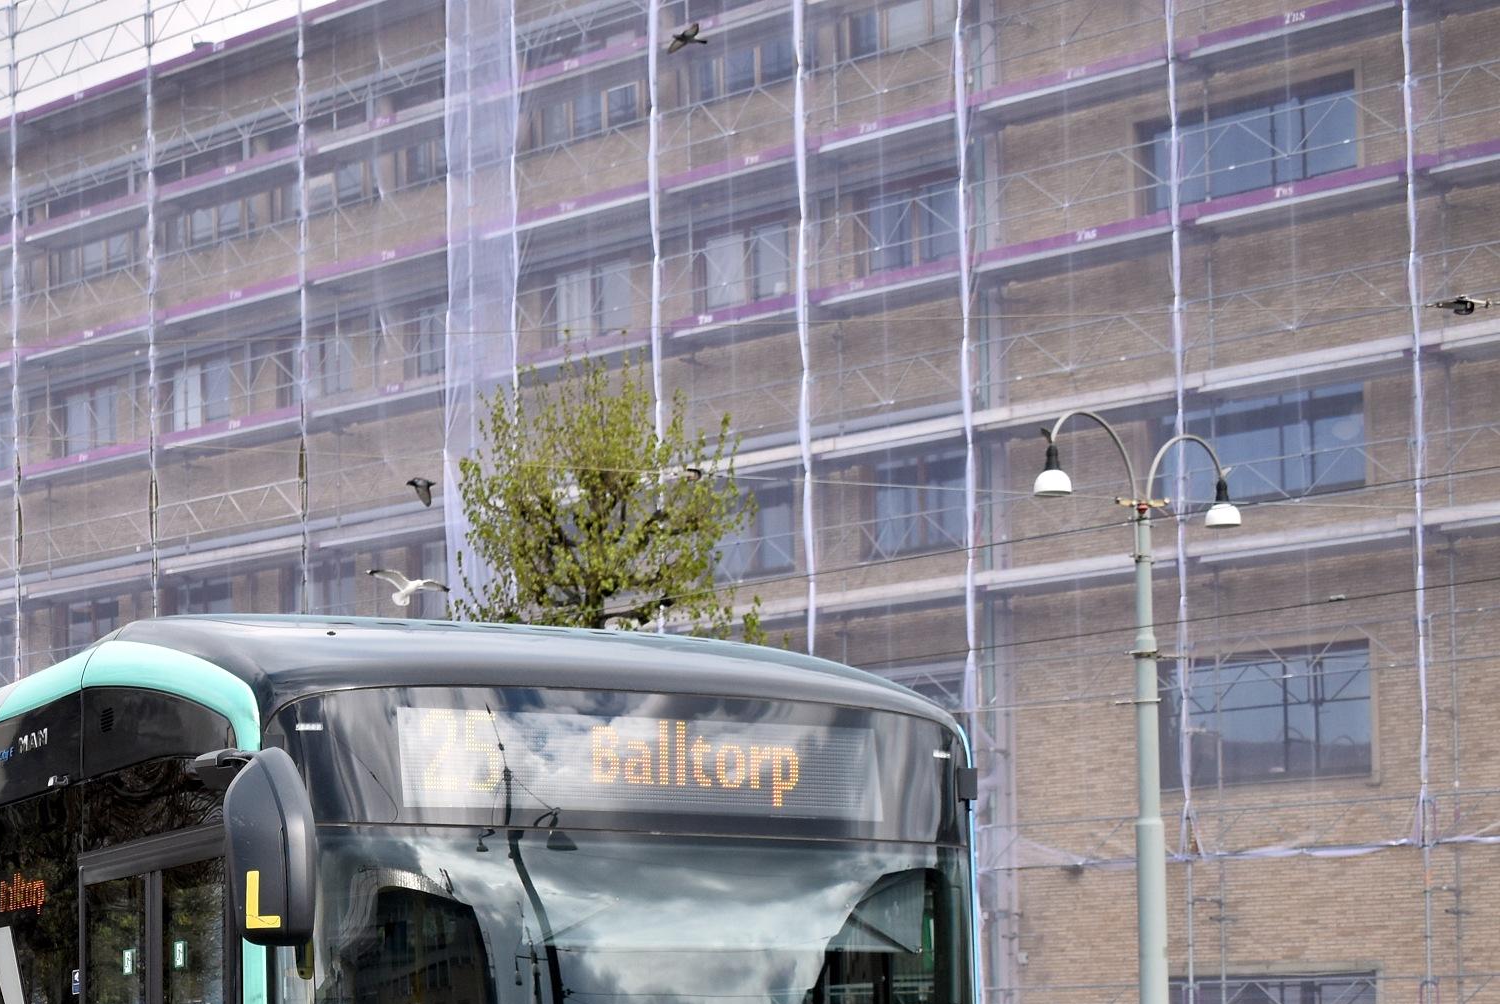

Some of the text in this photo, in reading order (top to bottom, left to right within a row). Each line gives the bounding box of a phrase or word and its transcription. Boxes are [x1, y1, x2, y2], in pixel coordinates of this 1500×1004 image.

[19, 727, 48, 754] MAN
[420, 708, 800, 807] 25 Balltorp
[0, 872, 45, 915] Balltorp
